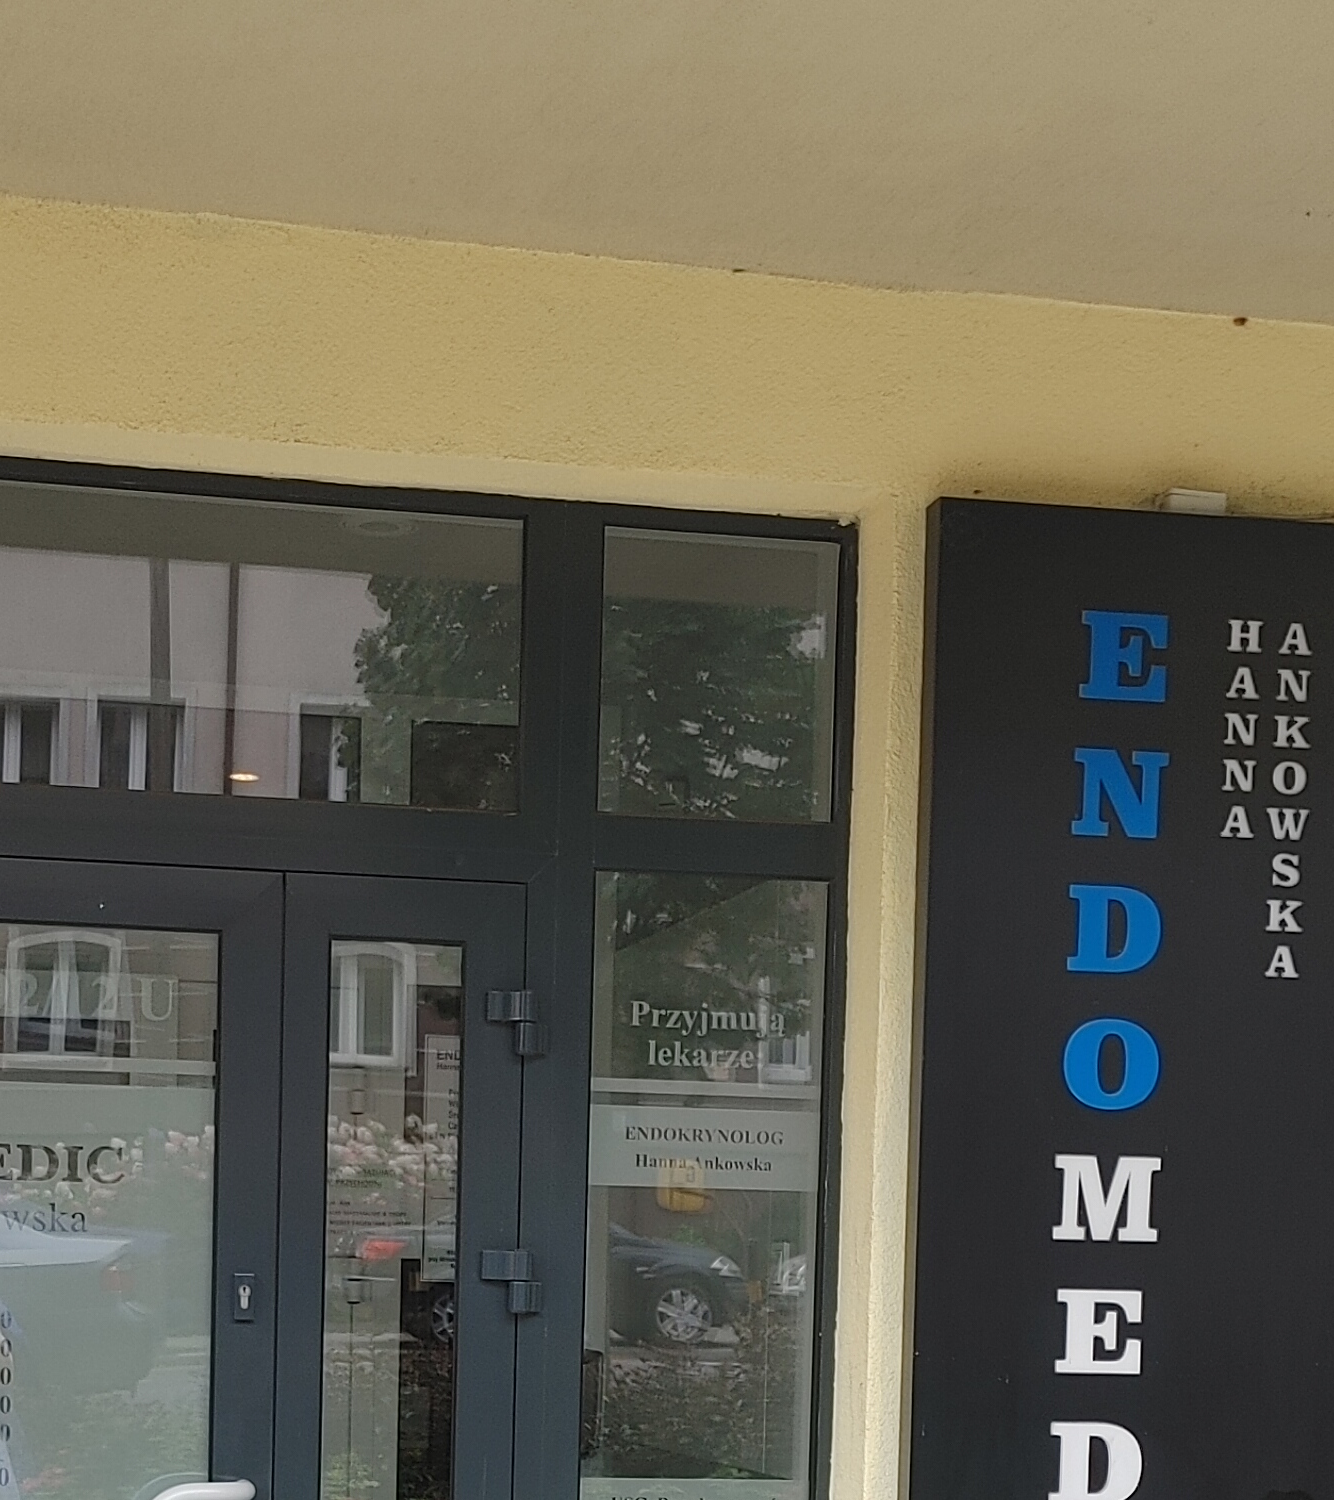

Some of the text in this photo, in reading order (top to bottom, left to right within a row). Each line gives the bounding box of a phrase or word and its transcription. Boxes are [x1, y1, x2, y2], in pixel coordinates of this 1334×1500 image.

[1220, 618, 1264, 839] HANNA
[1264, 621, 1313, 980] ANKOWSKA
[140, 978, 175, 1022] U
[630, 1000, 786, 1038] Przyjmują
[625, 1126, 785, 1145] ENDOKRYNOLOG
[635, 1153, 687, 1169] Hanna
